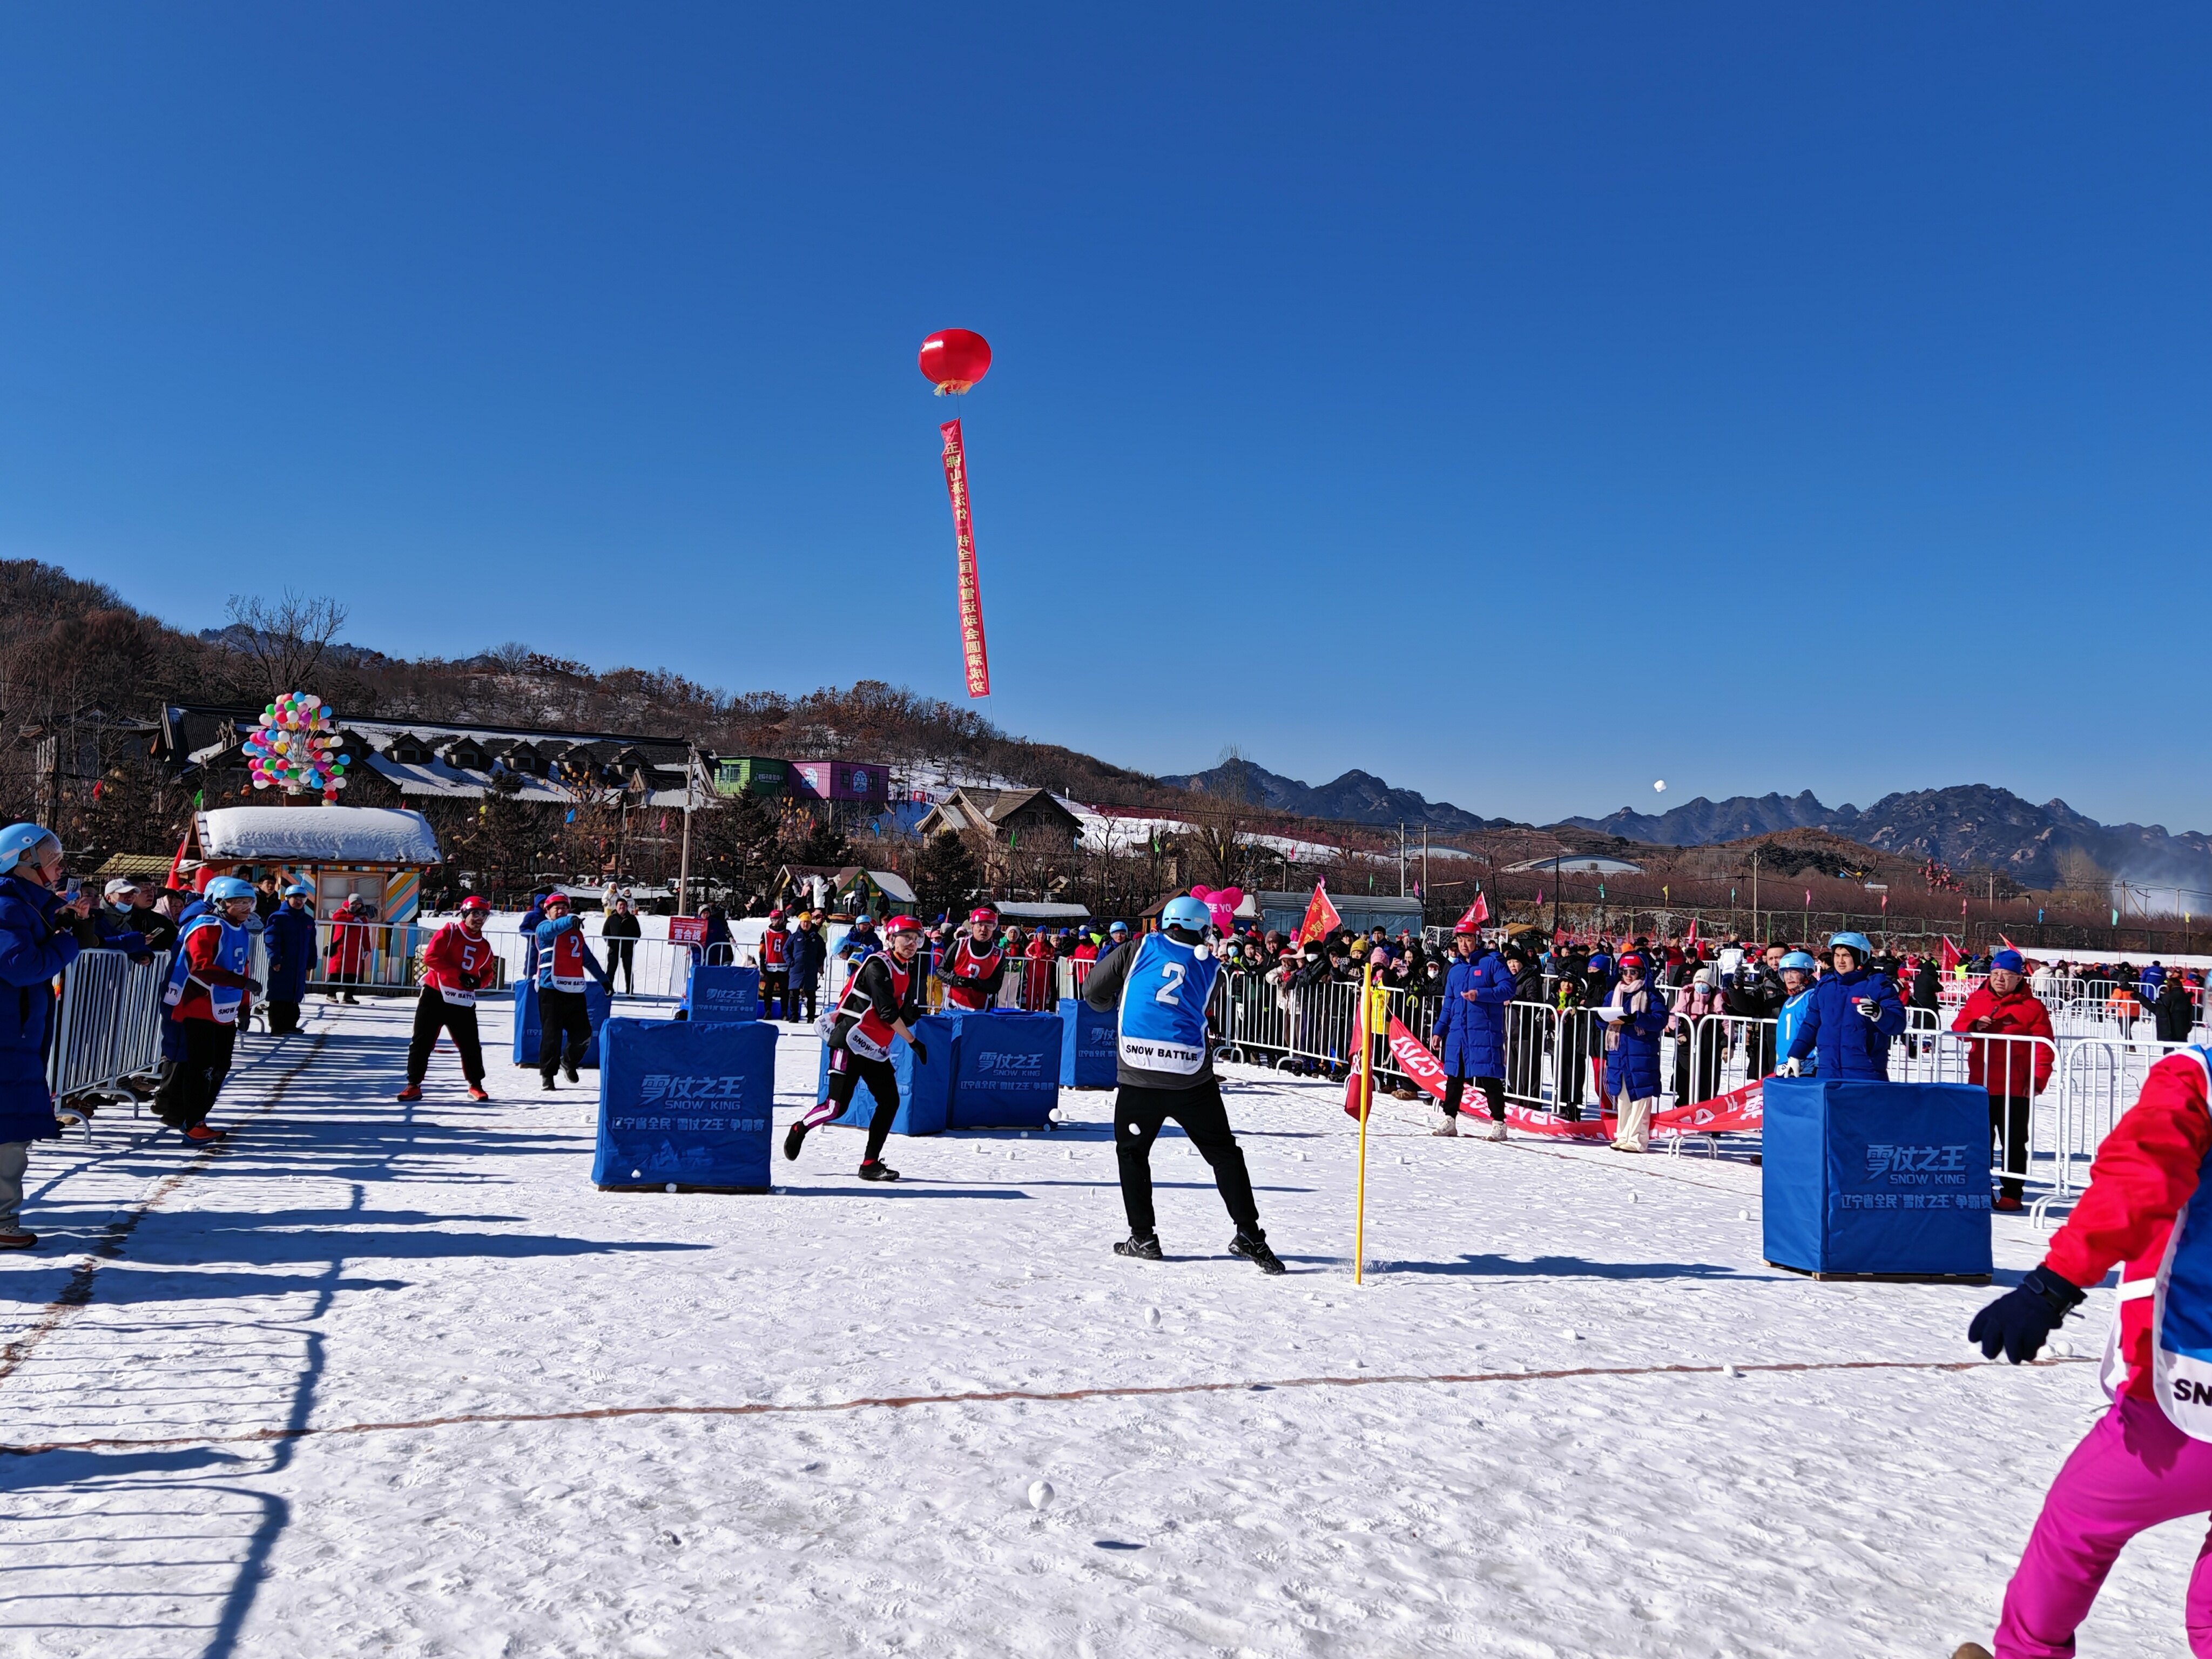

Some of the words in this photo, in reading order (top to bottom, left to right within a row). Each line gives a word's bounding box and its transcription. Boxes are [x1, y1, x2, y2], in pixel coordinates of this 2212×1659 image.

[570, 935, 580, 957] 2
[233, 947, 245, 974] 3
[461, 945, 477, 970] 5
[1155, 961, 1186, 1006] 2
[218, 1007, 235, 1015] SNOW
[1091, 1028, 1117, 1044] 雪仗
[1786, 1013, 1791, 1040] 1
[977, 1051, 1043, 1073] 雪仗之王
[1125, 1044, 1154, 1056] SNOW
[1157, 1048, 1198, 1062] BATTLE
[639, 1074, 745, 1106] 雪仗之王
[664, 1100, 704, 1110] SNOW
[710, 1101, 741, 1110] KING
[1866, 1144, 1968, 1181] 雪仗之王
[1890, 1174, 1928, 1184] SNOW
[1935, 1174, 1966, 1184] KING
